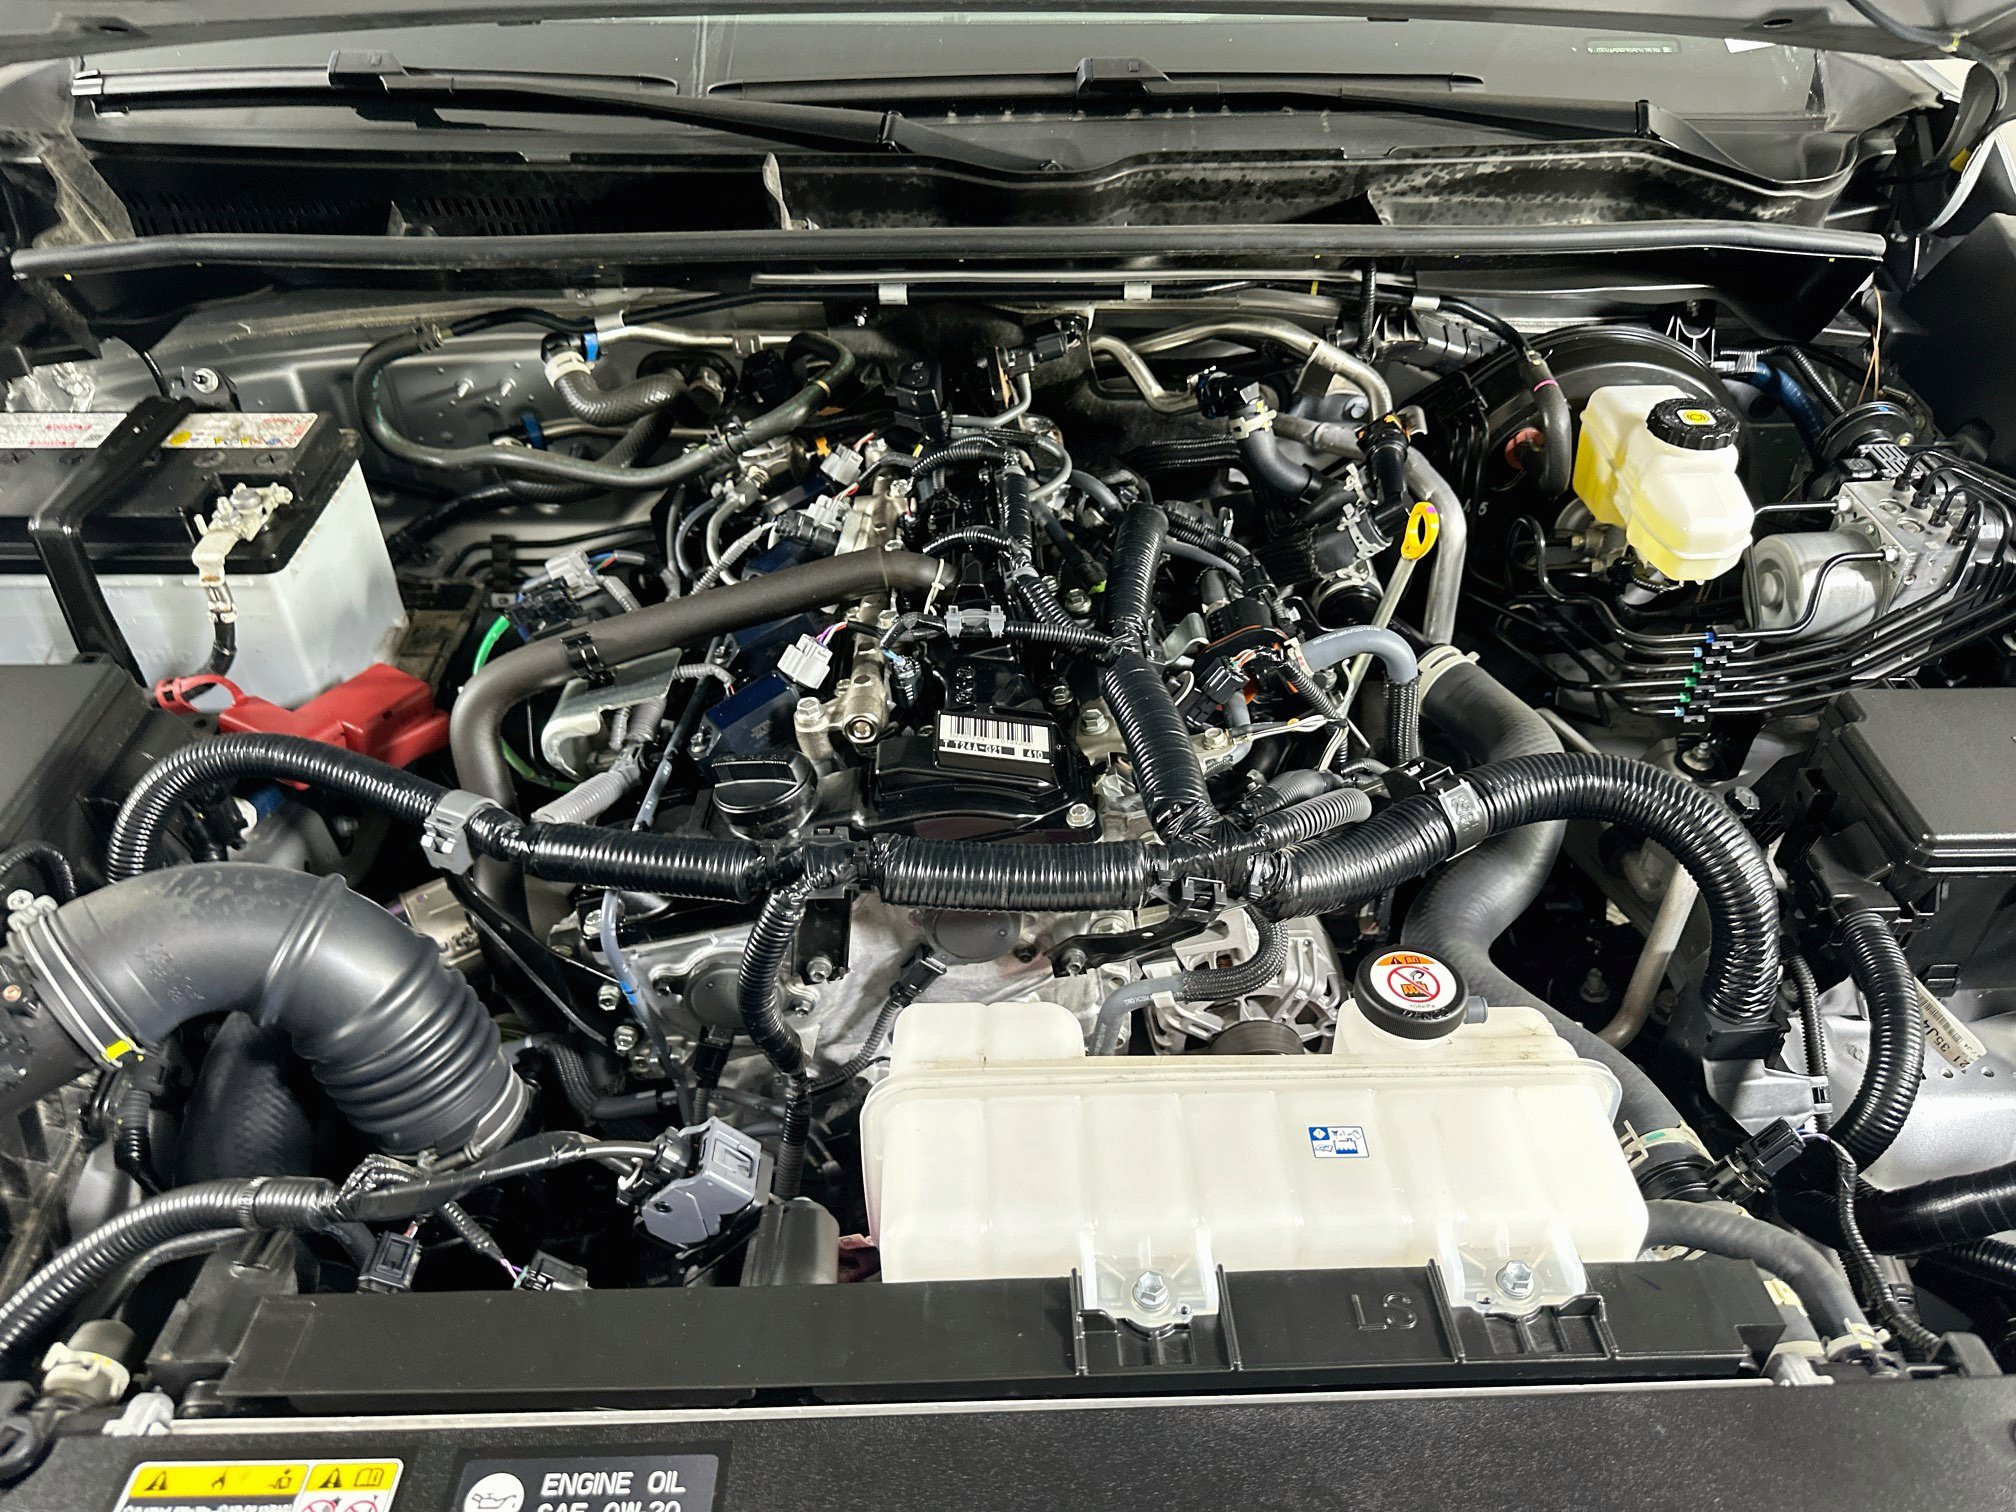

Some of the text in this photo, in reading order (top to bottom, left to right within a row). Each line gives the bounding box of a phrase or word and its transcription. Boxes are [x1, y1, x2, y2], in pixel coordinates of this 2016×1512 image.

[1026, 751, 1044, 759] 410
[1351, 1291, 1418, 1331] LS
[540, 1470, 686, 1496] ENGINE OIL
